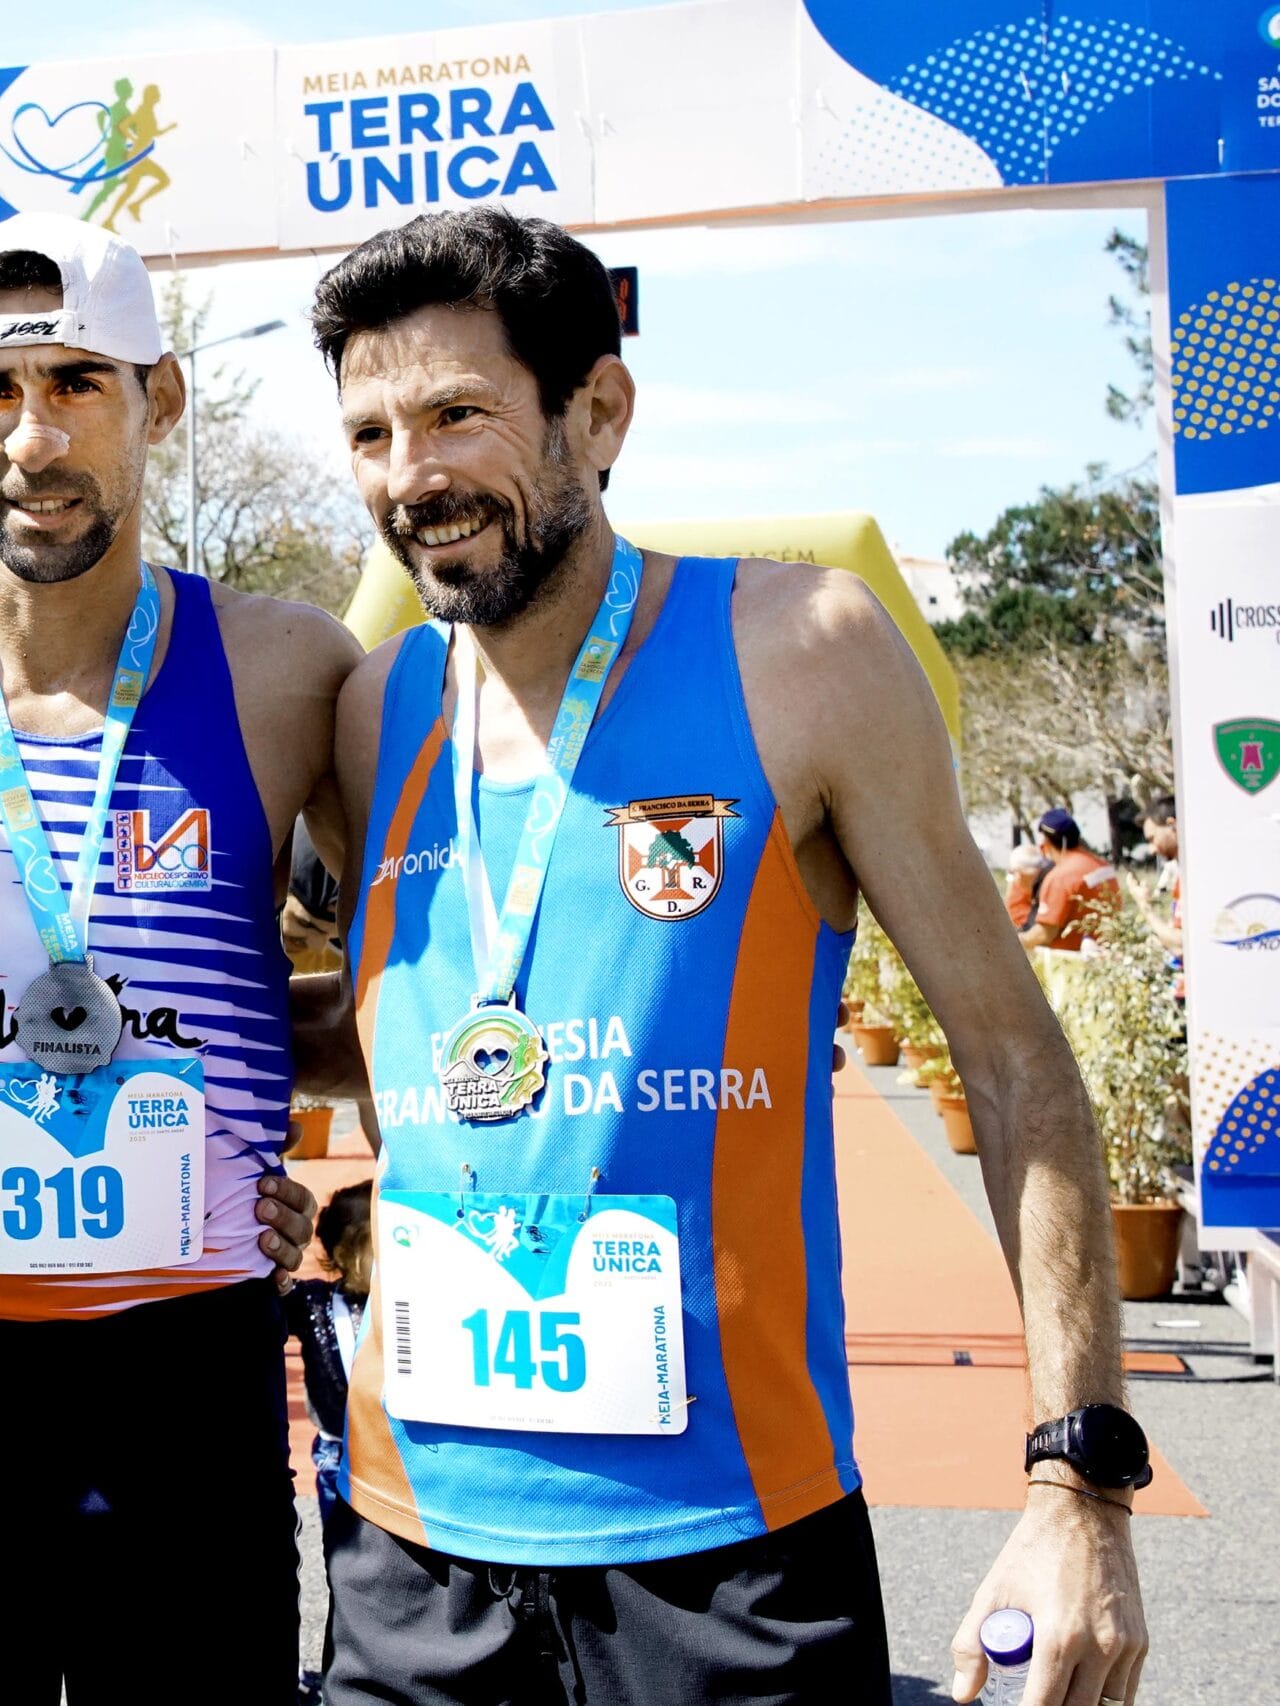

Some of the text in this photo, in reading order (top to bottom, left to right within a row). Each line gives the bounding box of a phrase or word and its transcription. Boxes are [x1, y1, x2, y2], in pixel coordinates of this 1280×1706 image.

[302, 53, 532, 96] MEIA MARATONA
[304, 82, 555, 153] TERRA
[306, 141, 558, 212] ÚNICA
[638, 801, 676, 811] FRANCISCO
[635, 877, 707, 892] G. R.
[667, 901, 681, 912] D.
[61, 912, 78, 950] MEIA
[33, 1041, 101, 1055] FINALISTA
[447, 1081, 499, 1096] TERRA
[563, 1071, 624, 1115] DA
[636, 1067, 772, 1112] SERRA
[128, 1098, 189, 1113] TERRA
[447, 1094, 501, 1111] ÚNICA
[128, 1112, 189, 1128] ÚNICA
[1, 1165, 124, 1240] 319
[180, 1152, 191, 1256] MEIA-MARATONA
[592, 1241, 661, 1256] TERRA
[461, 1308, 586, 1393] 145
[652, 1304, 671, 1425] MEIA-MARATONA
